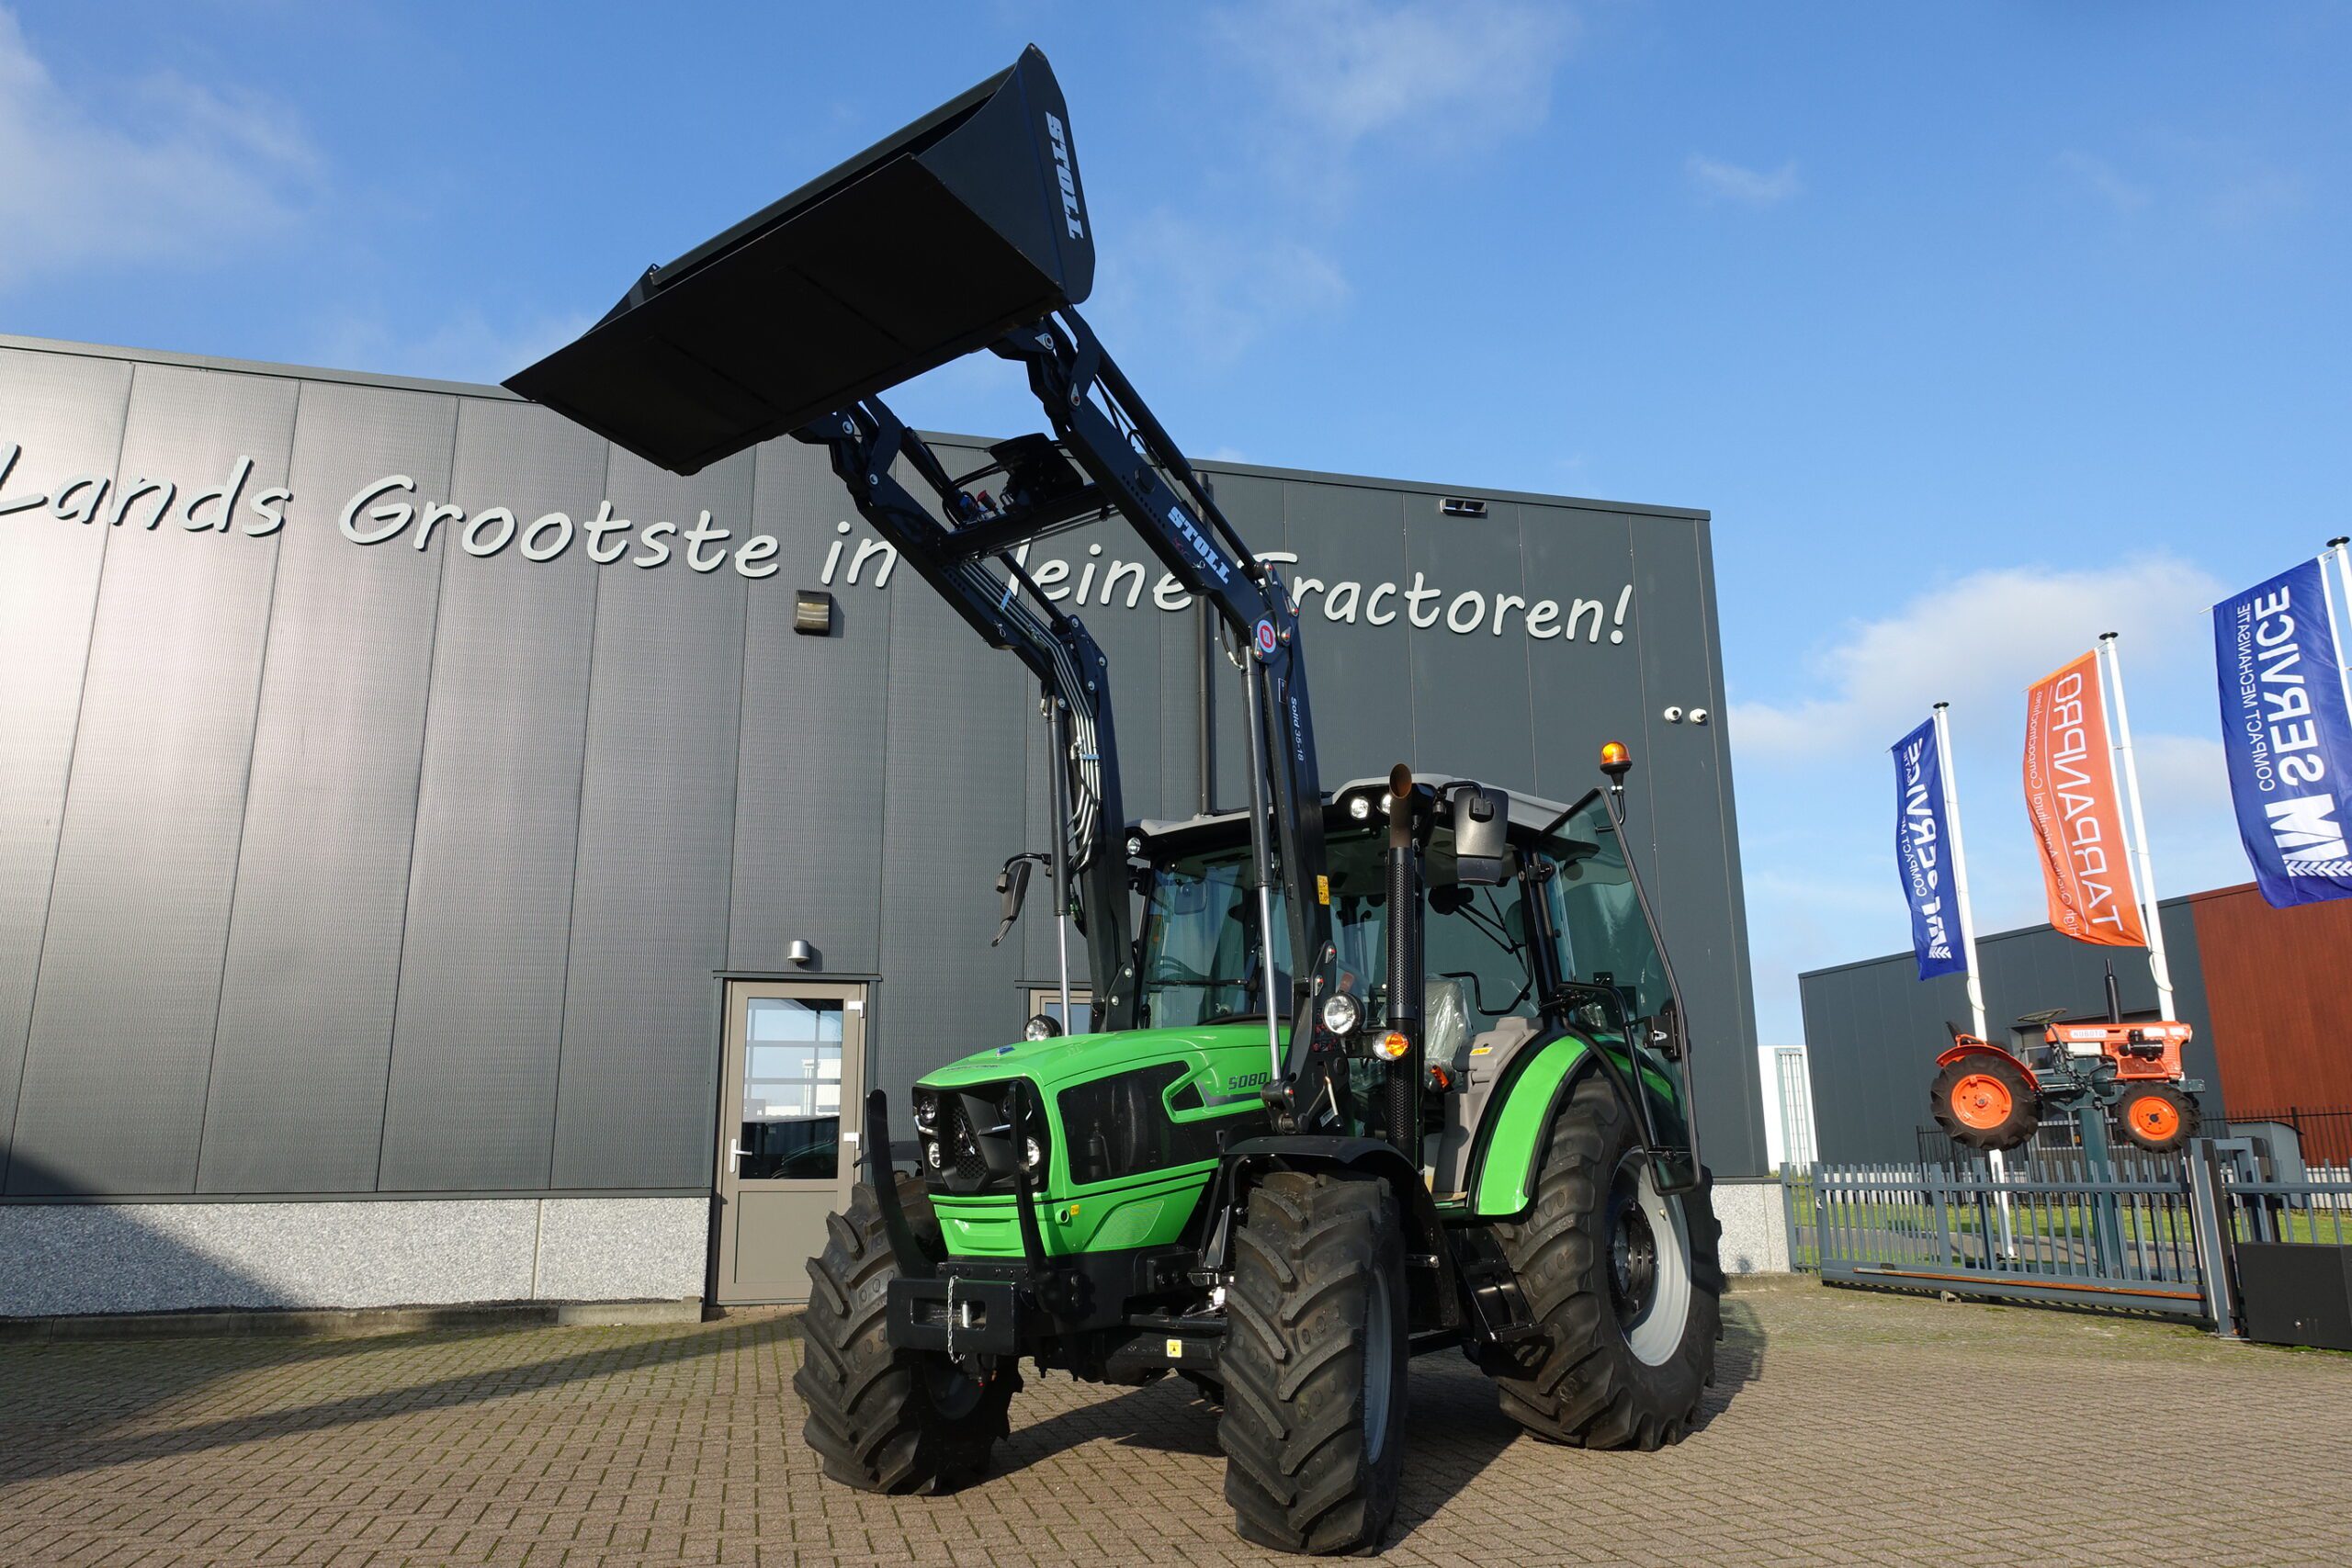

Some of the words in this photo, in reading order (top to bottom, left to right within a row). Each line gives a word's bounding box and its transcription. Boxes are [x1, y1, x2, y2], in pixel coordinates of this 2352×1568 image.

[1046, 111, 1084, 240] STOLL
[339, 475, 779, 578] Grootste
[820, 522, 898, 589] in
[1007, 537, 1193, 611] leine
[1168, 506, 1229, 584] STOLL
[1291, 696, 1300, 728] Solid
[1227, 1071, 1267, 1090] 5080
